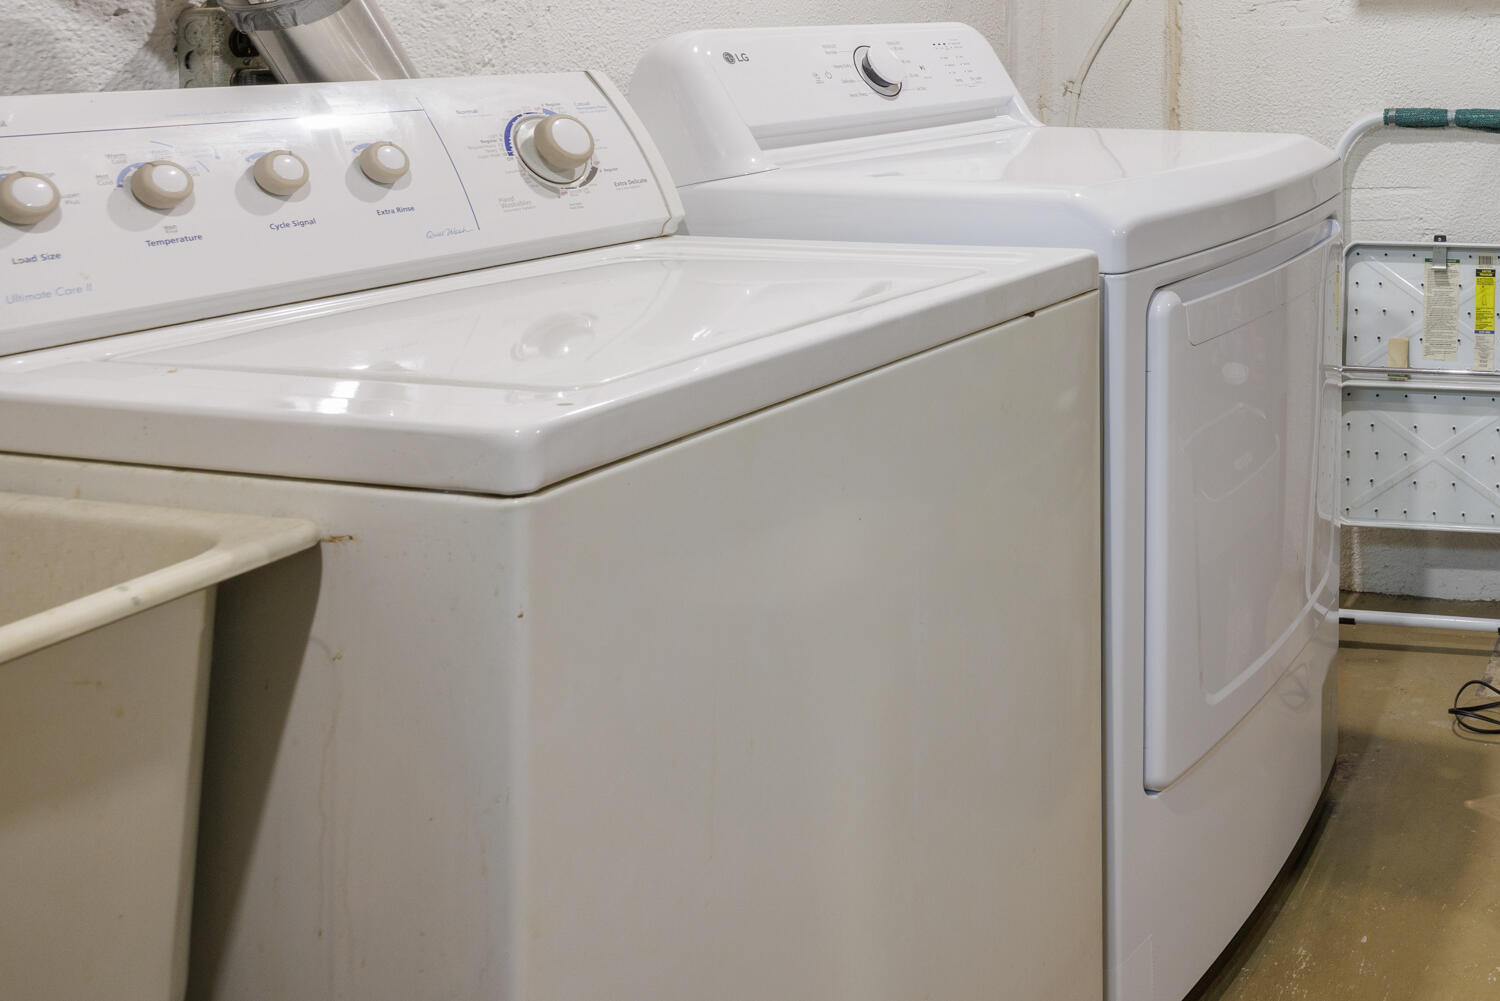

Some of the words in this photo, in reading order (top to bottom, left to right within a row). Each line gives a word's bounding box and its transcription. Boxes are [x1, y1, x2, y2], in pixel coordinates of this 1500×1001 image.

[269, 221, 290, 231] Cycle
[292, 217, 317, 229] Signal
[145, 234, 203, 248] Temperature
[12, 255, 37, 265] Load
[40, 253, 61, 262] Size
